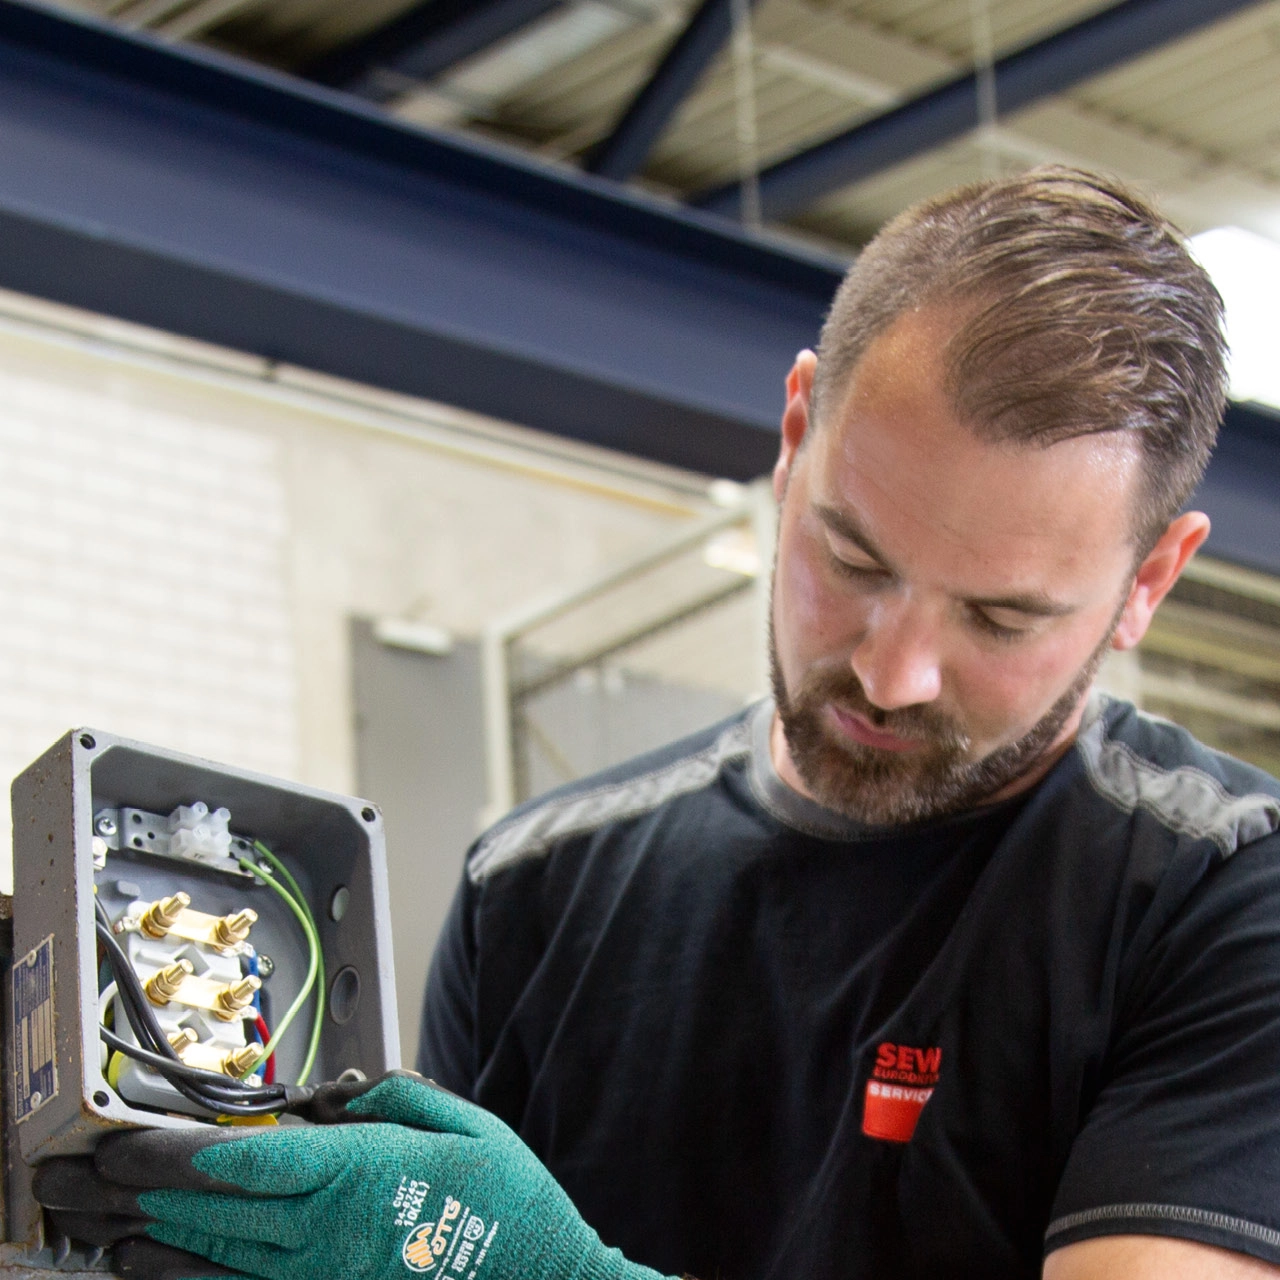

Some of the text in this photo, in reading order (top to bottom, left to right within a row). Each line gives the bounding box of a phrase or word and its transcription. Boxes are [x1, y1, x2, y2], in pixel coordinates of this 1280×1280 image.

[876, 1042, 942, 1072] SEW
[394, 1180, 418, 1227] 34-8743
[403, 1181, 430, 1227] 10(XL)
